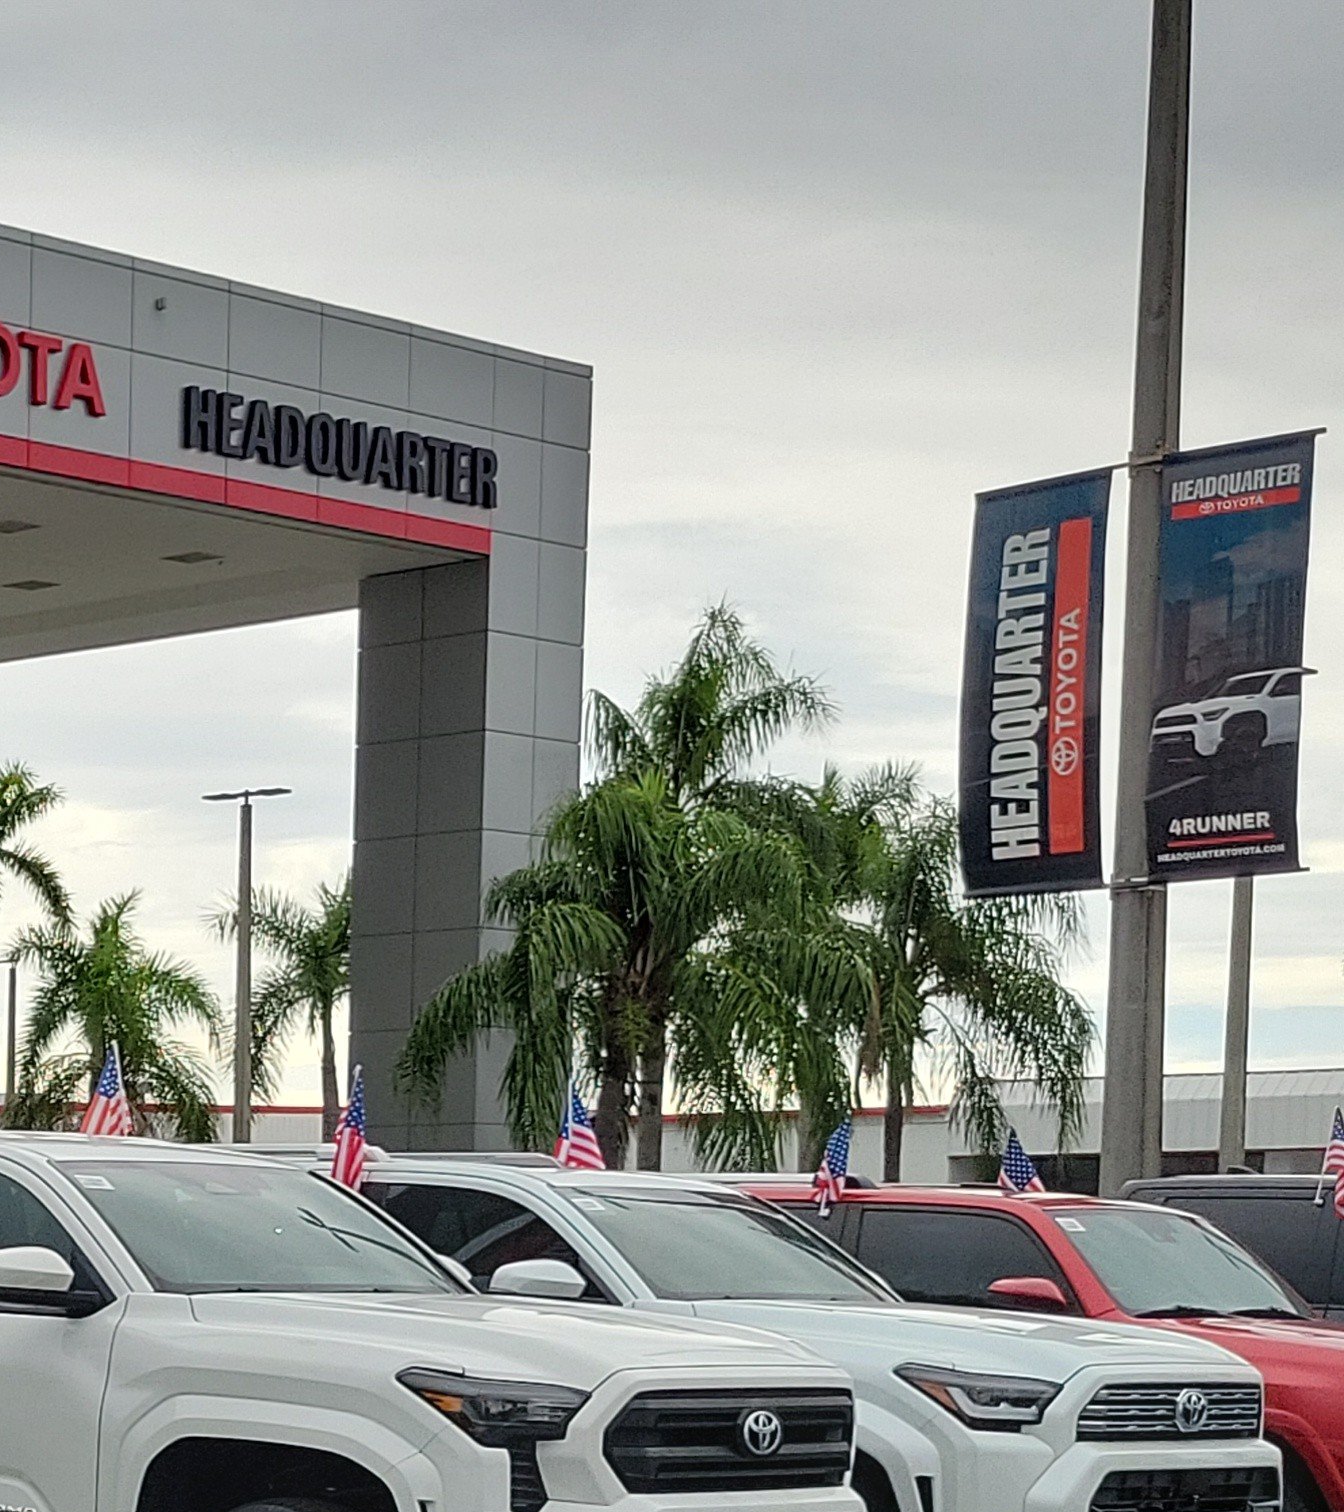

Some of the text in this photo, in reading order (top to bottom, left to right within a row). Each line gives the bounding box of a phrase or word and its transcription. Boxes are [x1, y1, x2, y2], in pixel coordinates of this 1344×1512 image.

[181, 384, 499, 509] HEADQUARTER
[1171, 462, 1301, 503] HEADQUARTER
[1216, 495, 1265, 511] TOYOTA
[1055, 608, 1082, 734] TOYOTA
[990, 526, 1052, 861] HEADQUARTER
[1168, 811, 1271, 836] 4RUNNER
[1157, 843, 1286, 863] HEADQUARTERTOYOTA.COM
